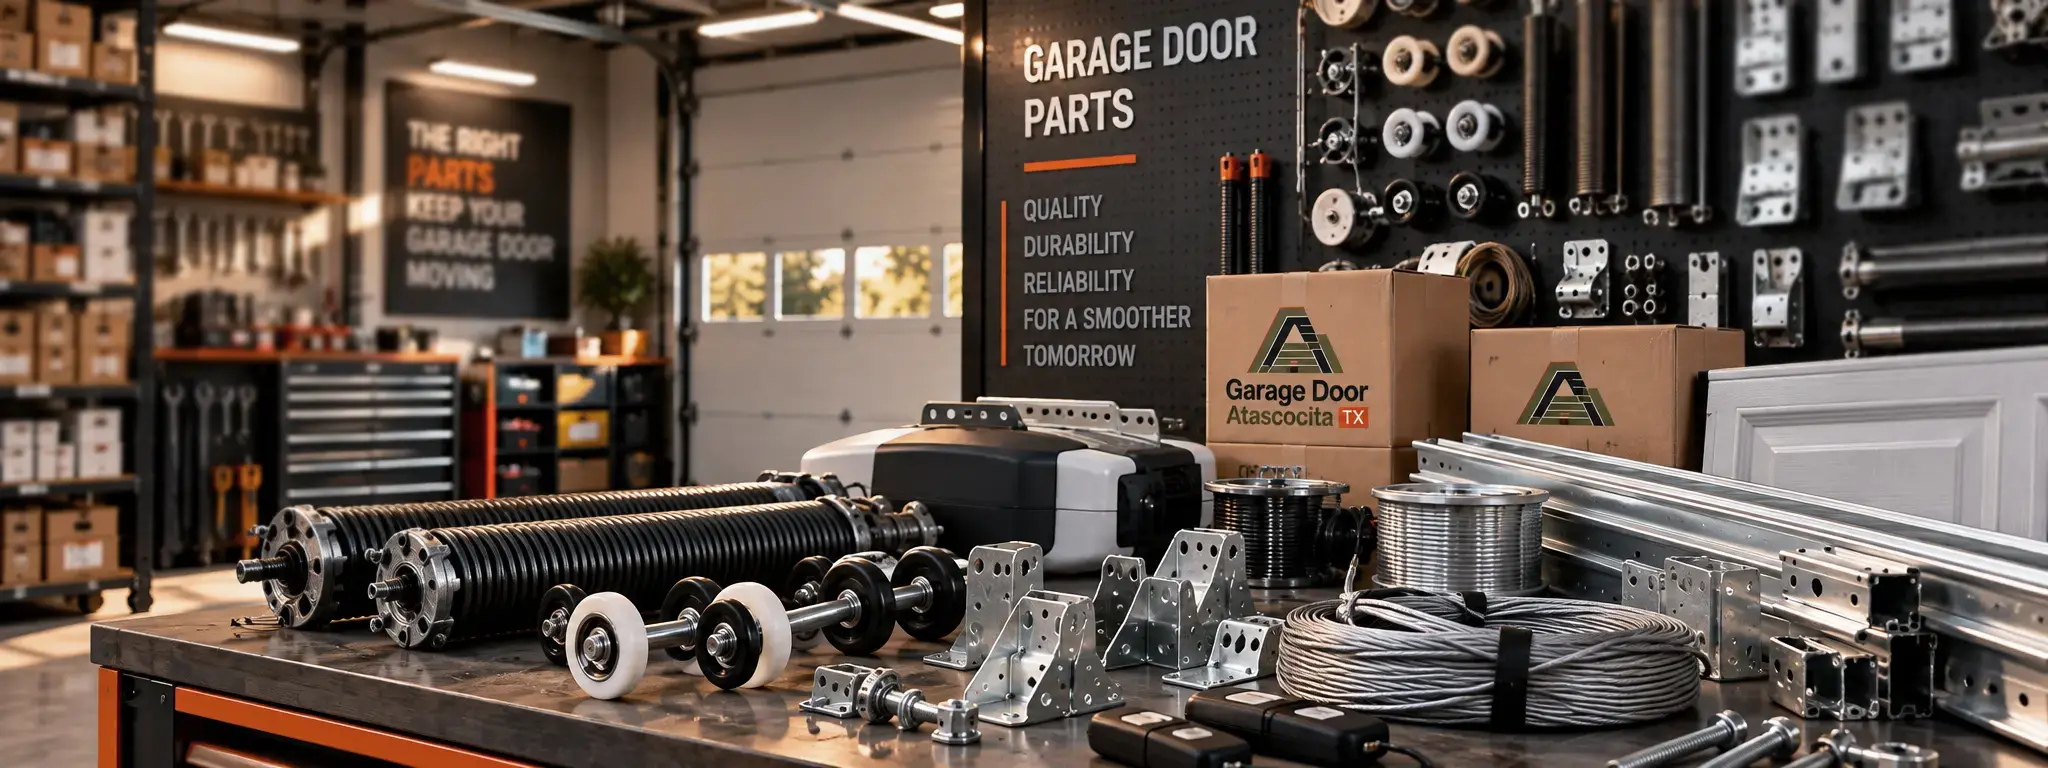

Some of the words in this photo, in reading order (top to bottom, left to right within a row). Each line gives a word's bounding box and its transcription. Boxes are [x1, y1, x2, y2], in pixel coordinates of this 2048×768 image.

[1023, 29, 1152, 84] GARAGE
[1163, 15, 1257, 66] DOOR
[1024, 88, 1134, 138] PARTS
[407, 120, 451, 153] THE
[456, 126, 522, 161] RIGHT
[407, 154, 495, 195] PARTS
[407, 192, 464, 223] KEEP
[468, 197, 525, 227] YOUR
[1023, 194, 1103, 222] QUALITY
[406, 225, 492, 259] GARAGE
[497, 231, 555, 262] DOOR
[1024, 230, 1135, 258] DURABILITY
[406, 260, 494, 291] MOVING
[1024, 269, 1134, 294] RELIABILITY
[1024, 308, 1059, 330] FOR
[1065, 308, 1079, 330] A
[1083, 305, 1192, 330] SMOOTHER
[1023, 344, 1136, 367] TOMORROW
[1226, 378, 1305, 406] Garage
[1312, 379, 1369, 402] Door
[1226, 405, 1334, 426] Atascocita
[1342, 409, 1365, 425] TX
